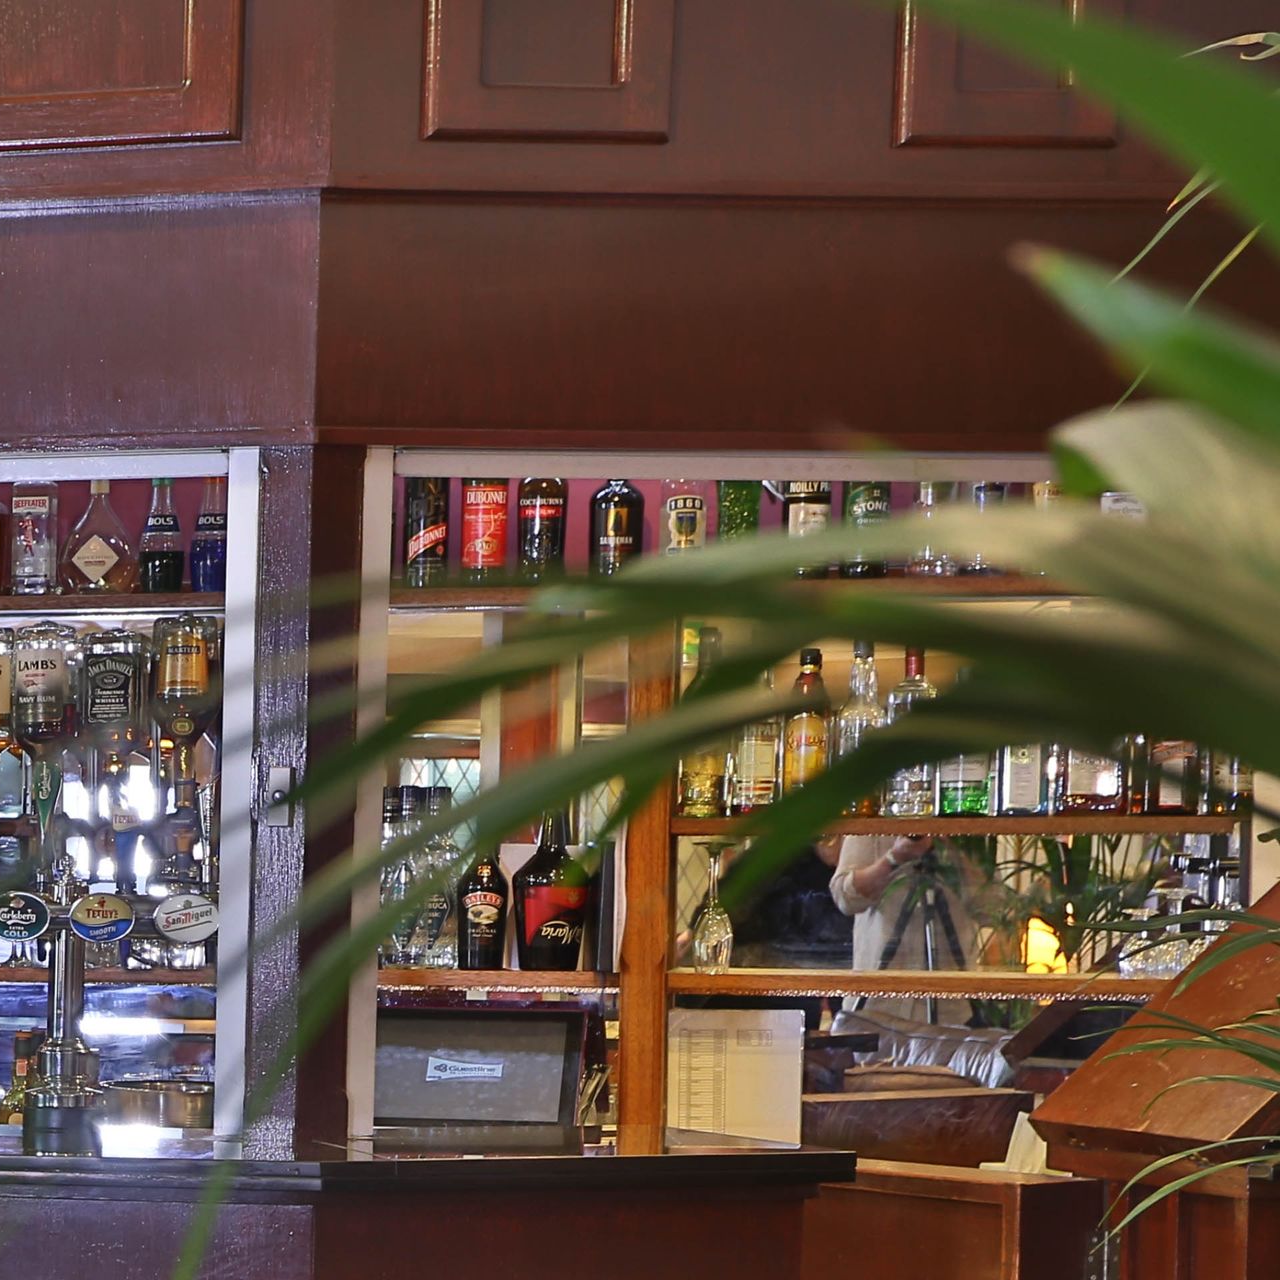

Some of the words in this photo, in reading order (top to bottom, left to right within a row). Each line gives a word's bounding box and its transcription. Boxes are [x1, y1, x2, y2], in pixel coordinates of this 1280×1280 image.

[790, 481, 818, 493] NOILLY
[14, 499, 48, 509] BEEFEATER
[148, 516, 174, 526] BOLS
[198, 516, 225, 525] BOLS
[408, 525, 447, 558] DUBONNET
[18, 658, 57, 672] LAMB'S
[88, 662, 106, 678] JACK
[105, 659, 134, 677] DANIEL'S
[36, 695, 56, 703] RUM
[464, 893, 501, 908] BAILEYS
[162, 913, 183, 930] San
[181, 907, 213, 926] Miguel
[3, 930, 29, 938] COLD
[89, 926, 117, 936] SMOOTH
